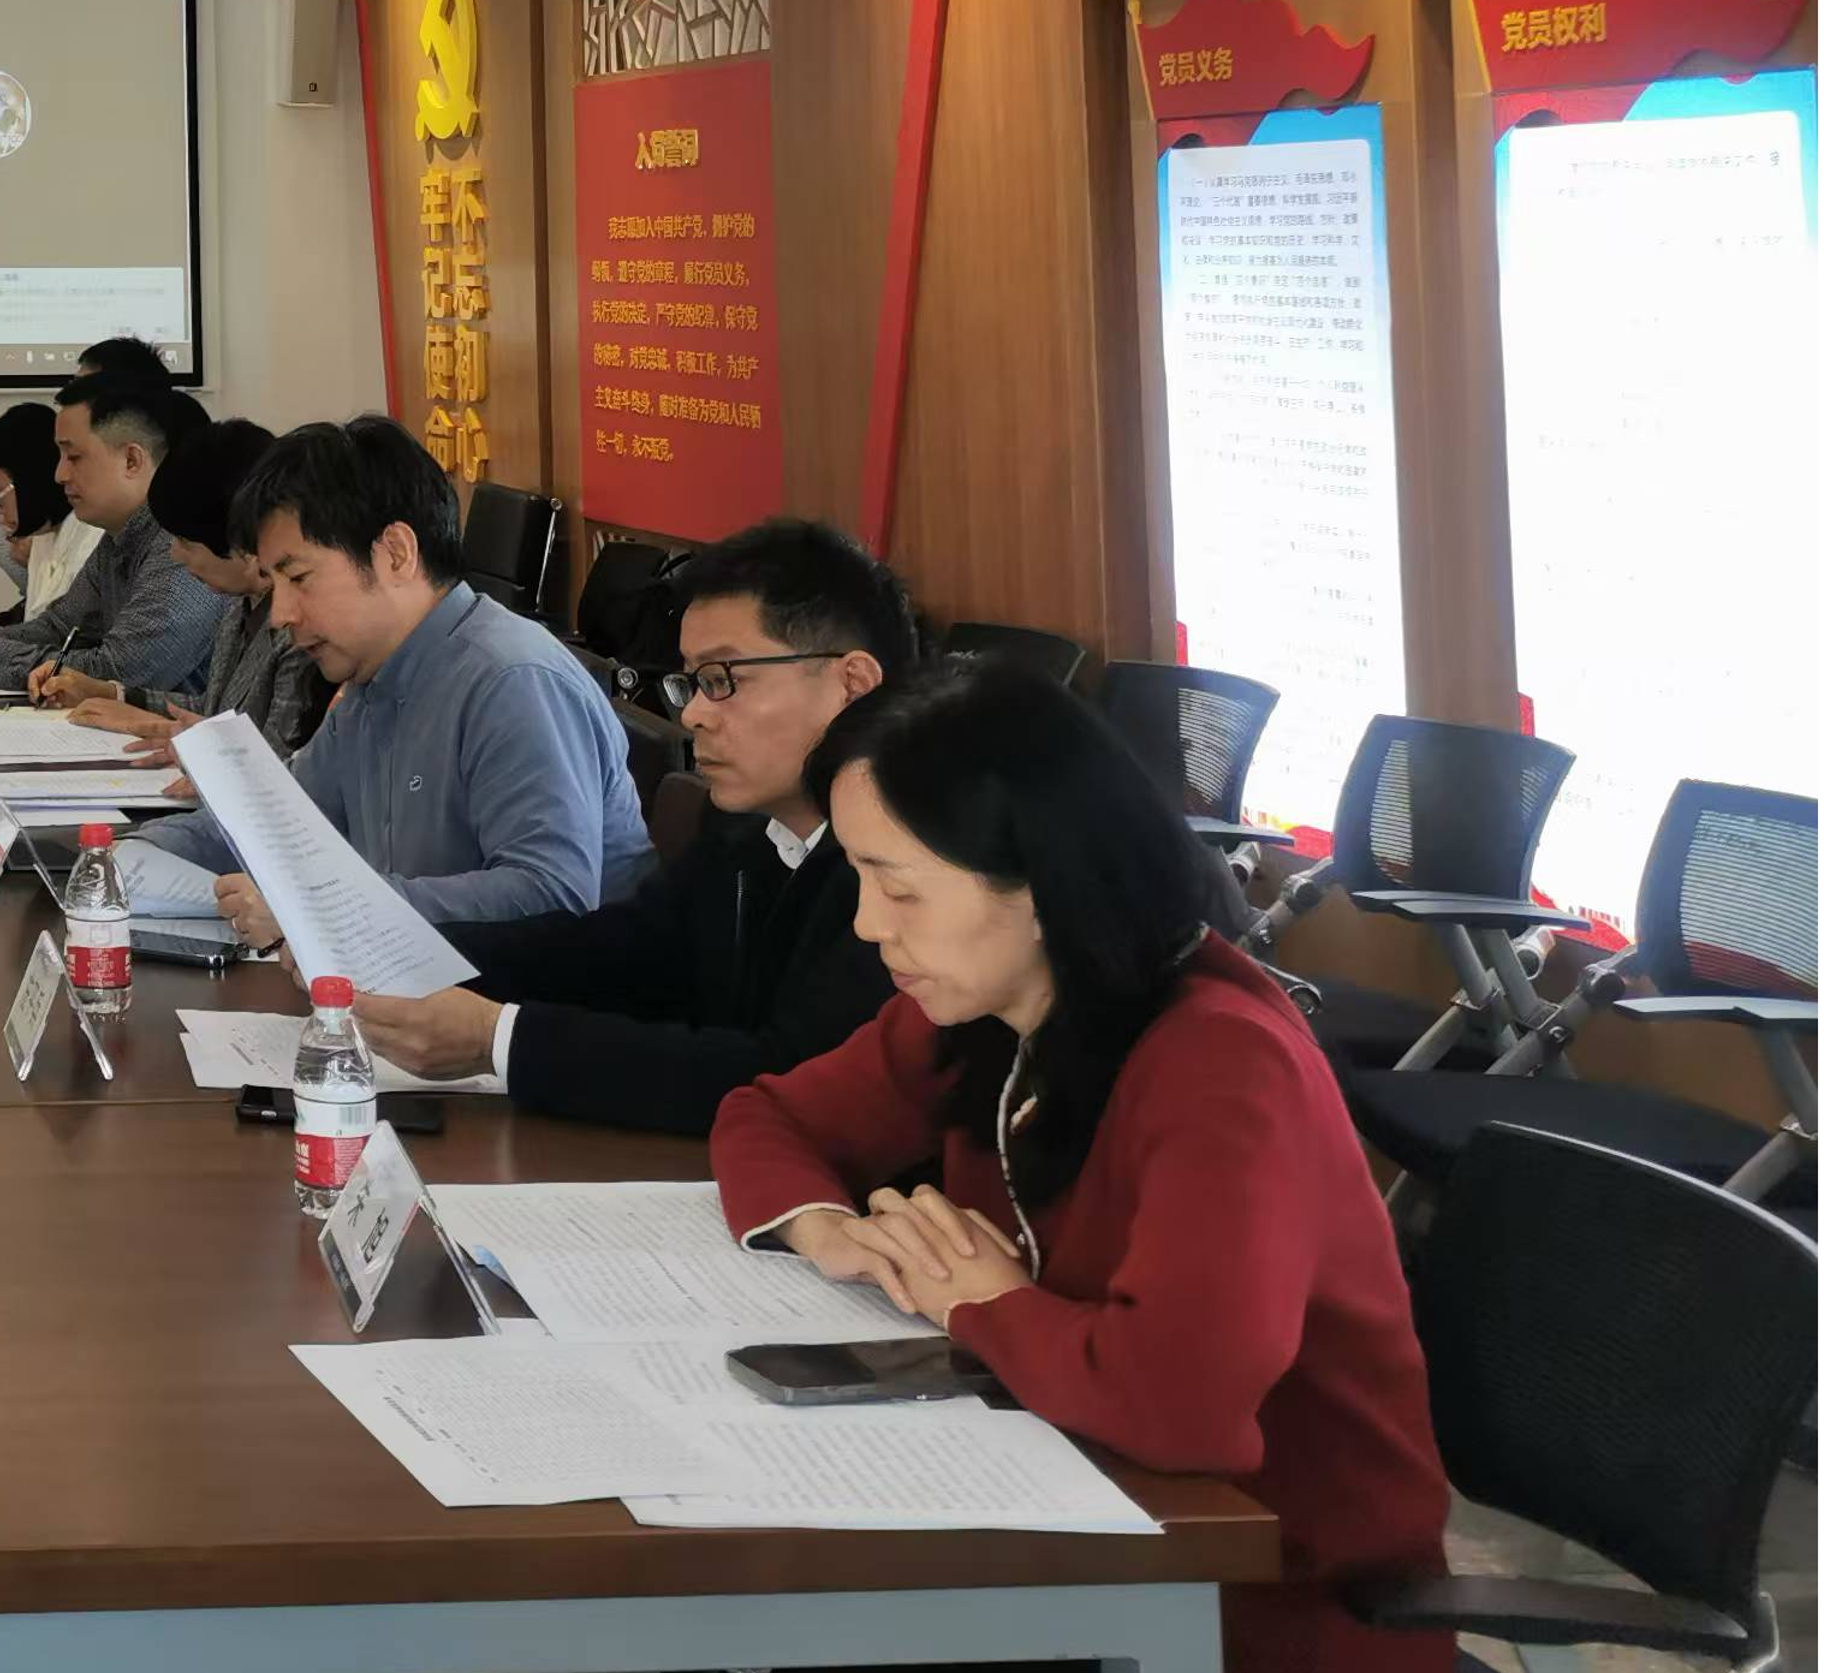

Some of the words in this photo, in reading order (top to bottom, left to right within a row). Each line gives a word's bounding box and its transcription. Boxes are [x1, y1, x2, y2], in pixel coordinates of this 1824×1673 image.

[1501, 3, 1606, 52] 党员权利
[1159, 47, 1233, 86] 党员义务
[635, 130, 698, 169] 入党誓词
[419, 169, 454, 475] 牢记使命
[452, 169, 489, 484] 不忘初心
